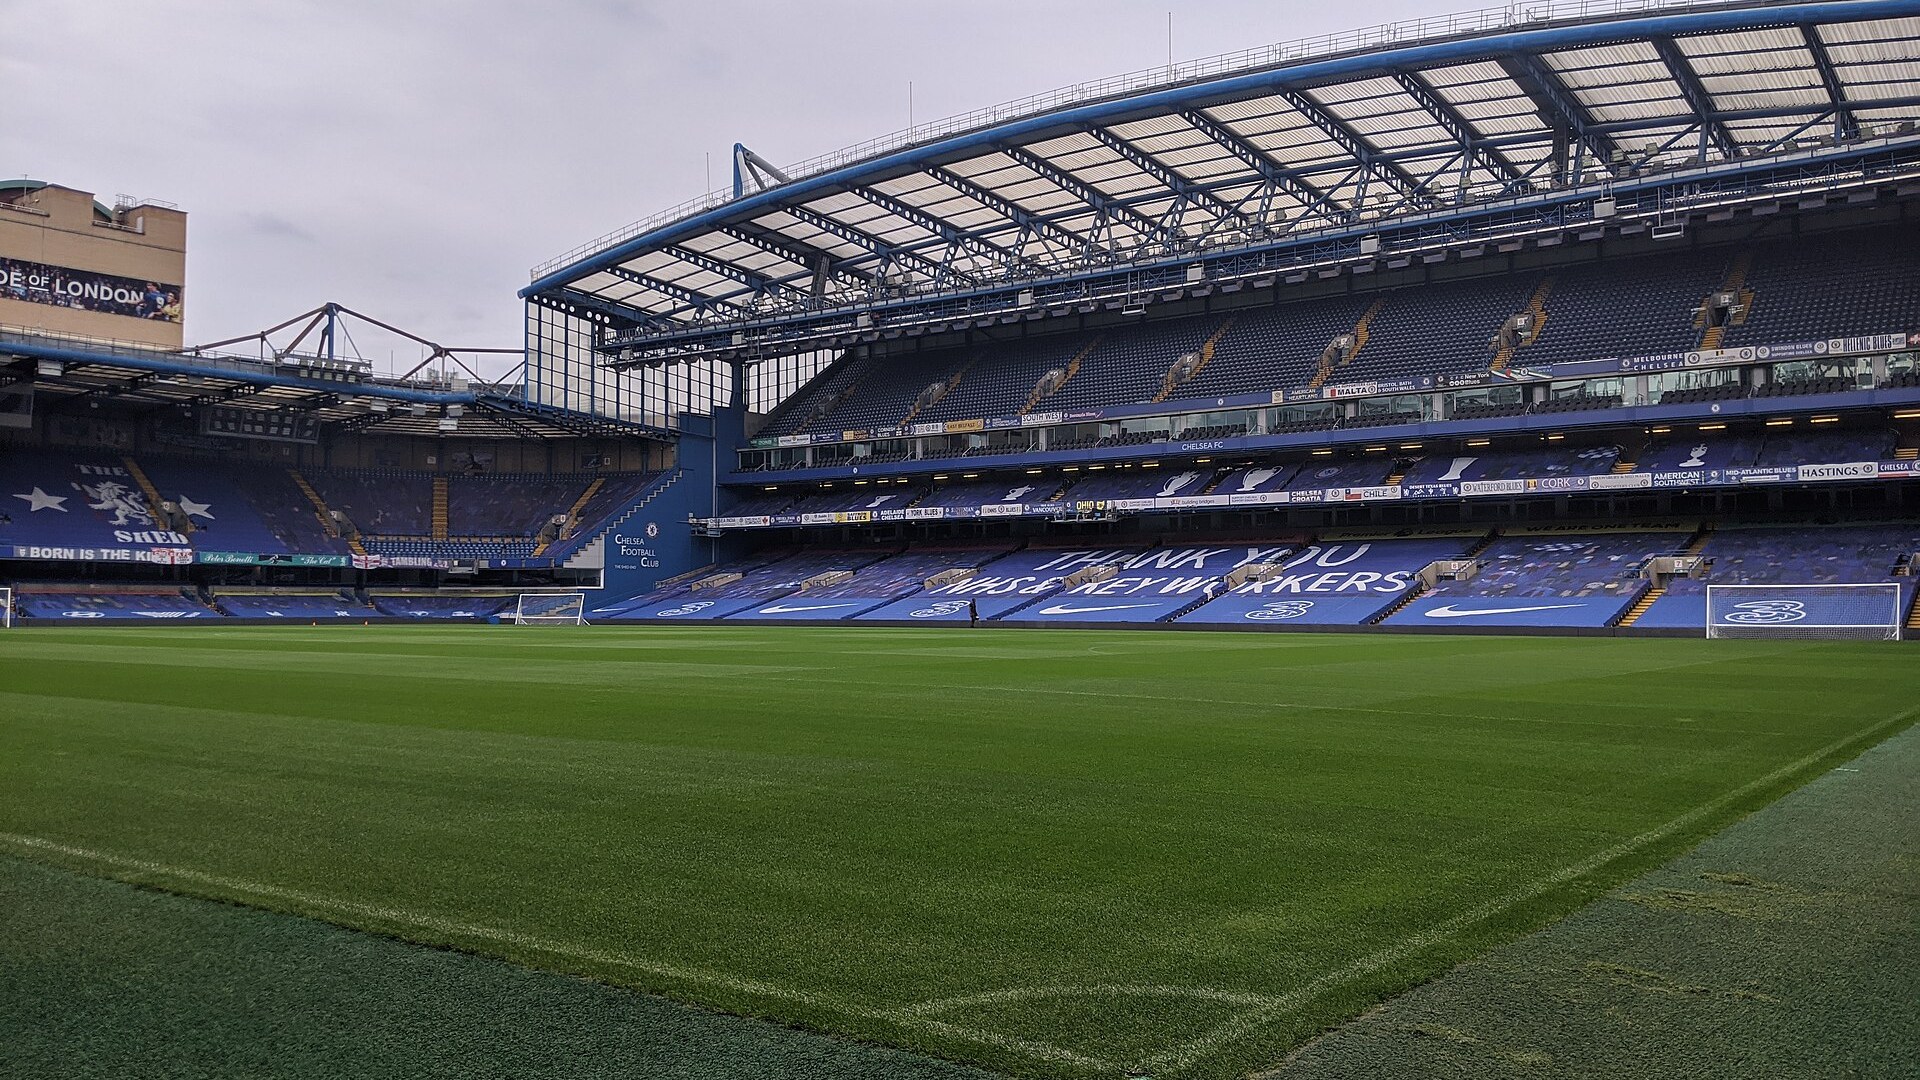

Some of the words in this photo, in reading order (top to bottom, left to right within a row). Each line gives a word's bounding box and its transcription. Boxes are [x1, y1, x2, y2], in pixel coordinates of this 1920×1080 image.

[28, 274, 50, 287] OF
[55, 279, 144, 304] LONDON
[1873, 335, 1892, 350] BLUES
[1634, 353, 1684, 363] MELBOURNE
[1634, 362, 1684, 371] CHELSEA
[1337, 386, 1368, 396] MALTA
[1022, 413, 1044, 422] SOUTH
[1044, 411, 1062, 420] WEST
[1182, 442, 1213, 451] CHELSEA
[1213, 441, 1224, 449] FC
[75, 464, 129, 476] THE
[1726, 468, 1774, 476] MID-ATLANTIC
[1802, 466, 1859, 477] HASTINGS
[1880, 463, 1909, 471] CHELSEA
[1653, 471, 1700, 480] AMERICAN
[1541, 477, 1571, 489] CORK
[1653, 478, 1700, 487] SOUTHWEST
[1291, 489, 1322, 497] CHELSEA
[1363, 489, 1388, 498] CHILE
[1076, 500, 1094, 509] OHIO
[910, 509, 923, 517] YORK
[924, 508, 938, 516] BLUES
[114, 530, 189, 545] SHED
[615, 534, 645, 545] CHELSEA
[30, 547, 75, 560] BORN
[79, 549, 95, 560] IS
[100, 549, 131, 560] THE
[621, 545, 656, 557] FOOTBALL
[204, 552, 224, 563] Peter
[224, 553, 254, 564] Bonetti
[391, 556, 432, 568] TAMBLING
[641, 557, 660, 568] CLUB
[1033, 548, 1231, 571] THANK
[929, 576, 1037, 595] NHS
